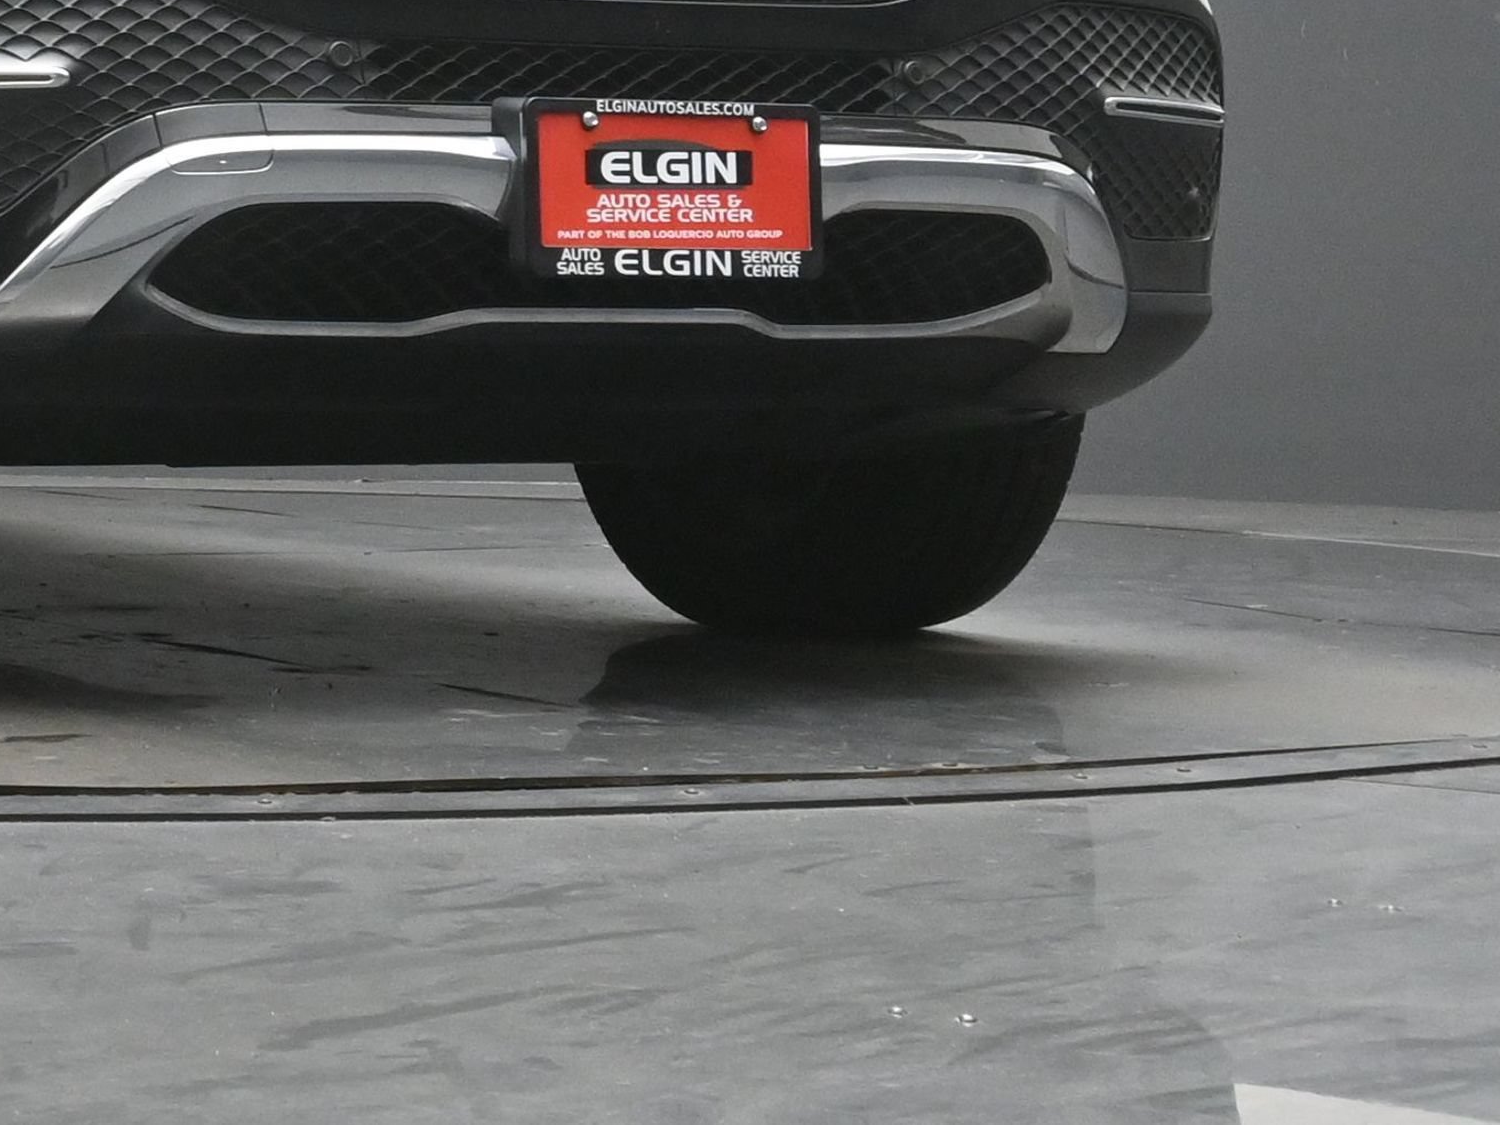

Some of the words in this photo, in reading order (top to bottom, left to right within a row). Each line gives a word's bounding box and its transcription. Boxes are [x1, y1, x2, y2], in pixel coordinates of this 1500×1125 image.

[596, 99, 755, 116] ELGINAUTOSALES.COM
[600, 151, 737, 184] ELGIN
[596, 194, 651, 208] AUTO
[657, 194, 721, 208] SALES
[727, 194, 743, 208] &
[586, 208, 671, 223] SERVICE
[677, 208, 754, 223] CENTER
[557, 230, 585, 239] PART
[587, 230, 603, 239] OF
[605, 230, 627, 239] THE
[628, 230, 651, 239] BOB
[653, 230, 714, 239] LOQUERCIO
[716, 230, 745, 239] AUTO
[746, 230, 783, 239] GROUP
[561, 248, 601, 261] AUTO
[741, 250, 802, 264] SERVICE
[556, 261, 605, 276] SALES
[614, 249, 732, 277] ELGIN
[743, 264, 799, 278] CENTER
